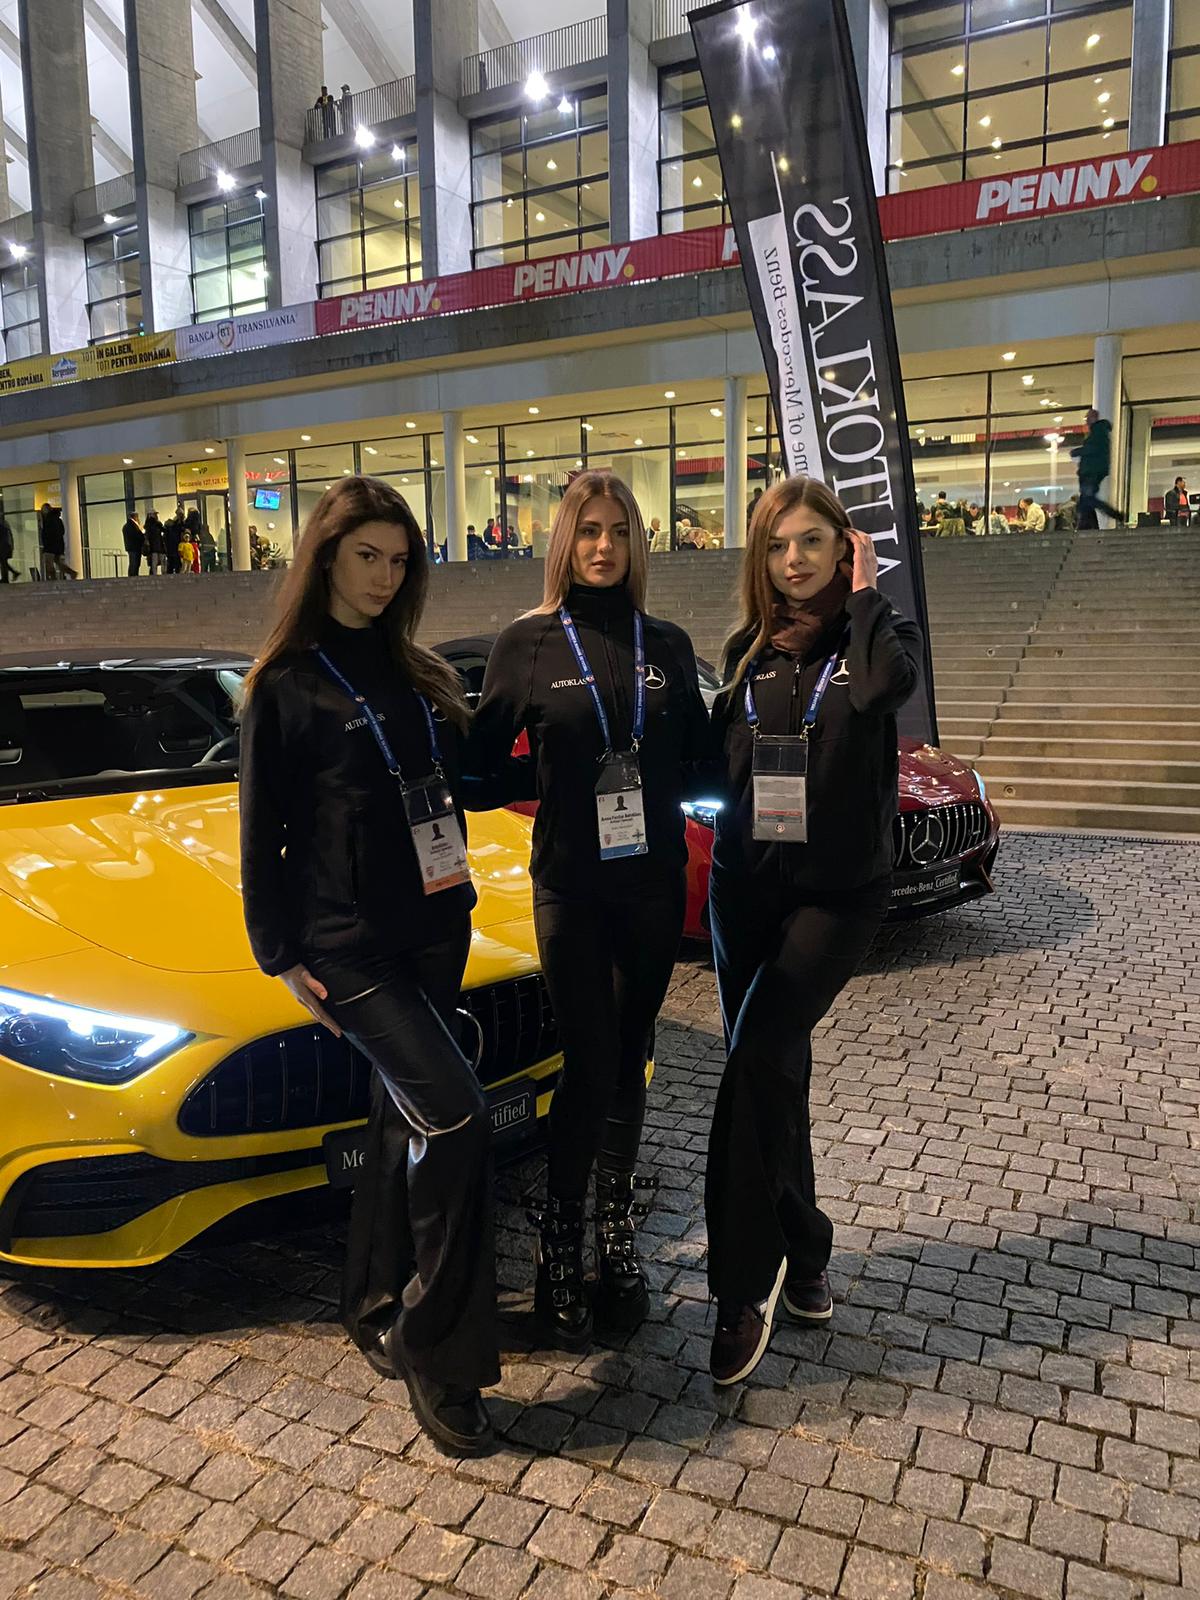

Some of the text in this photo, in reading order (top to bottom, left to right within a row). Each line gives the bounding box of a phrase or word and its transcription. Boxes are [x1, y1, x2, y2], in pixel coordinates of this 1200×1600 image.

[188, 314, 296, 344] BANCA BT TRANSILVANIA
[111, 355, 137, 368] PENTRU
[139, 347, 171, 363] ROMÂNIA
